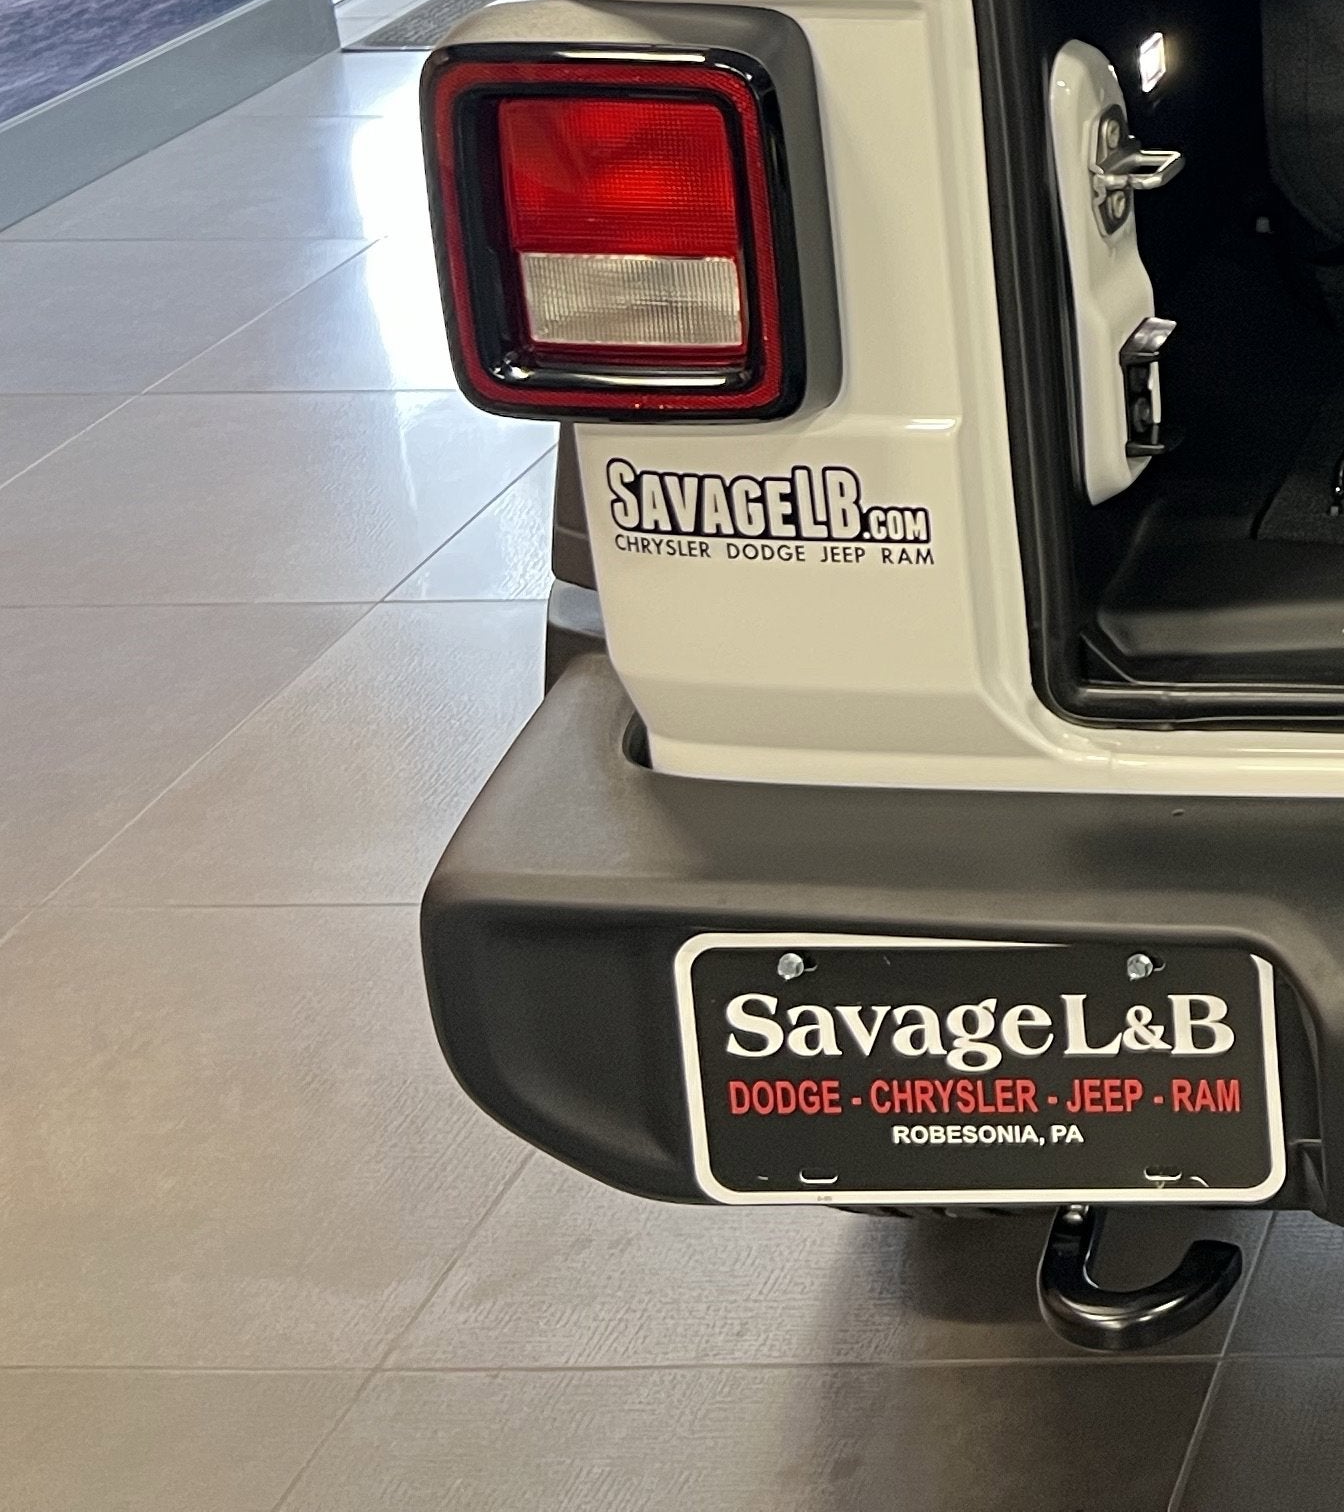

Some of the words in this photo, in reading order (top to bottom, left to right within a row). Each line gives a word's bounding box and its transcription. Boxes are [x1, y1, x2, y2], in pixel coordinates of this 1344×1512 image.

[615, 533, 711, 559] CHRYSLER
[726, 542, 806, 561] DODGE
[820, 545, 866, 564] JEEP
[881, 547, 935, 565] RAM
[728, 1080, 842, 1115] DODGE
[870, 1079, 1038, 1115] CHRYSLER
[1066, 1079, 1143, 1113] JEEP
[1171, 1079, 1242, 1113] RAM
[892, 1124, 1045, 1146] ROBESONIA,
[1050, 1124, 1084, 1143] PA
